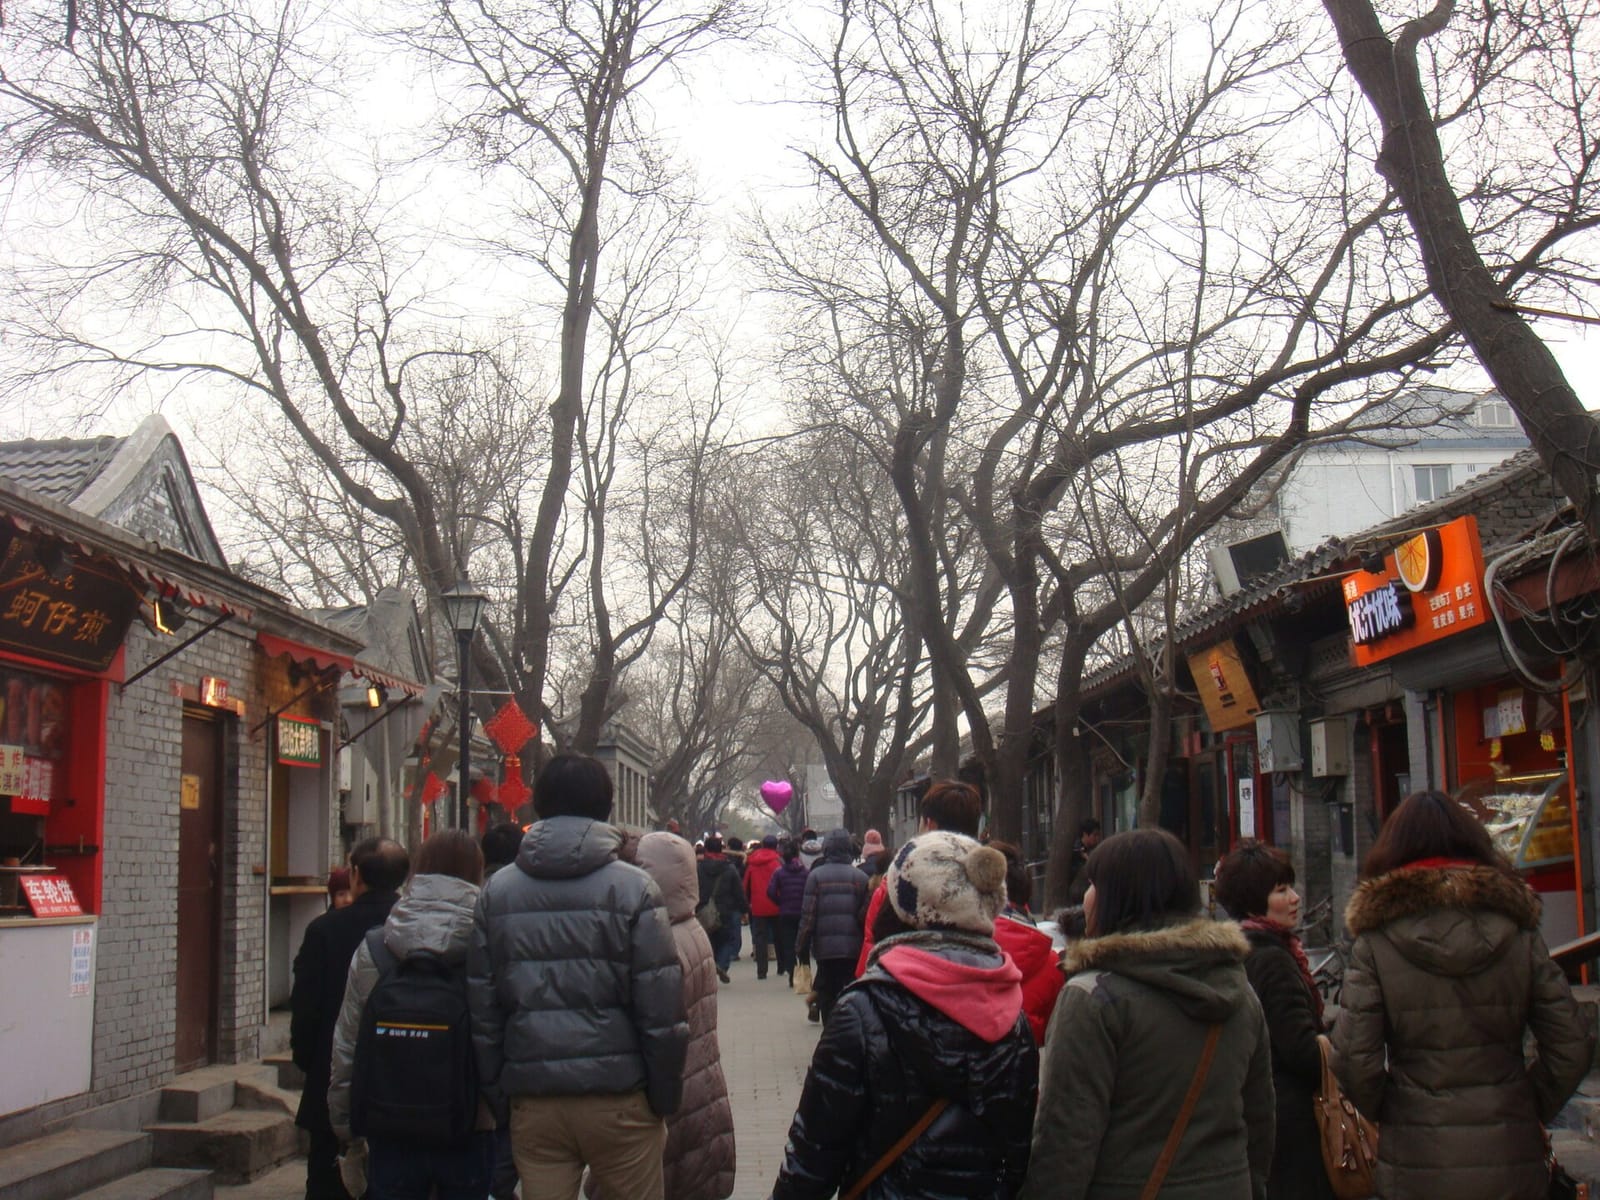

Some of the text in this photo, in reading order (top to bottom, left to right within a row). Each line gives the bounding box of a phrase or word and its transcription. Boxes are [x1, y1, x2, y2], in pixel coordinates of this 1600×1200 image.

[3, 588, 112, 646] 蚵仔煎
[26, 879, 76, 904] 车轮饼
